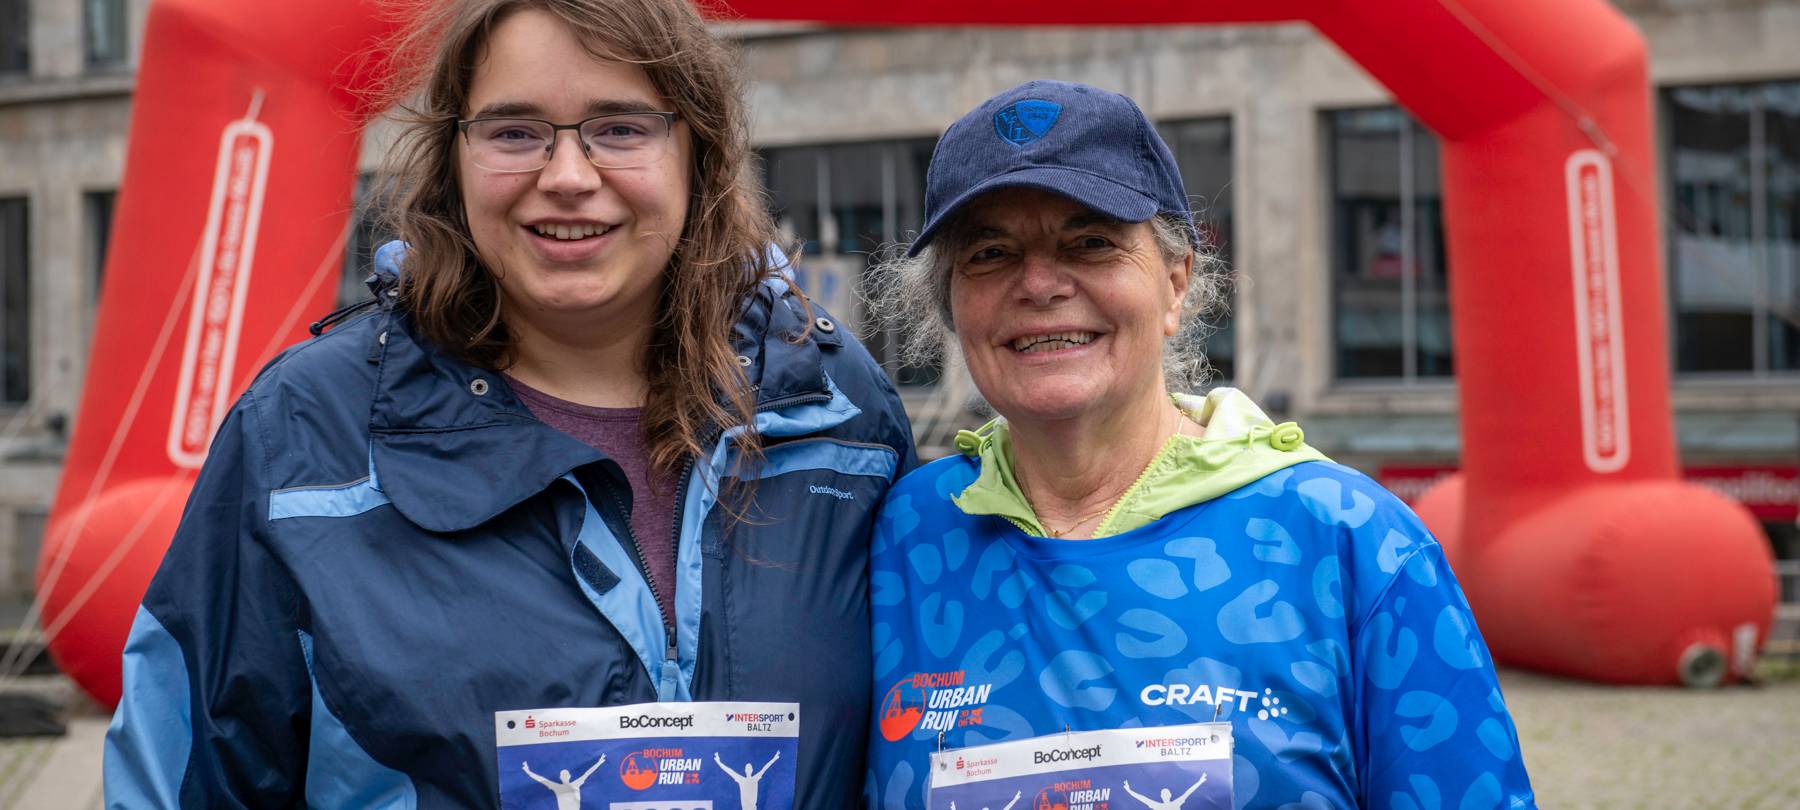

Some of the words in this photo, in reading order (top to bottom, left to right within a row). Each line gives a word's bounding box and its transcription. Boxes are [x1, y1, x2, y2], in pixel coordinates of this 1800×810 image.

[912, 671, 965, 688] BOCHUM
[928, 684, 992, 709] URBAN
[1140, 684, 1258, 712] CRAFT
[538, 719, 577, 729] Sparkasse
[619, 714, 694, 730] BoConcept
[734, 713, 784, 722] INTERSPORT
[920, 709, 960, 731] RUN
[539, 729, 570, 738] Bochum
[747, 723, 772, 731] BALTZ
[1145, 737, 1207, 748] INTERSPORT
[643, 748, 683, 759] BOCHUM
[1034, 744, 1102, 765] BoConcept
[1160, 748, 1191, 757] BALTZ
[660, 758, 702, 772] URBAN
[966, 758, 998, 769] Sparkasse
[658, 771, 684, 785] RUN
[1054, 779, 1091, 792] BOCHUM
[1070, 788, 1111, 804] URBAN
